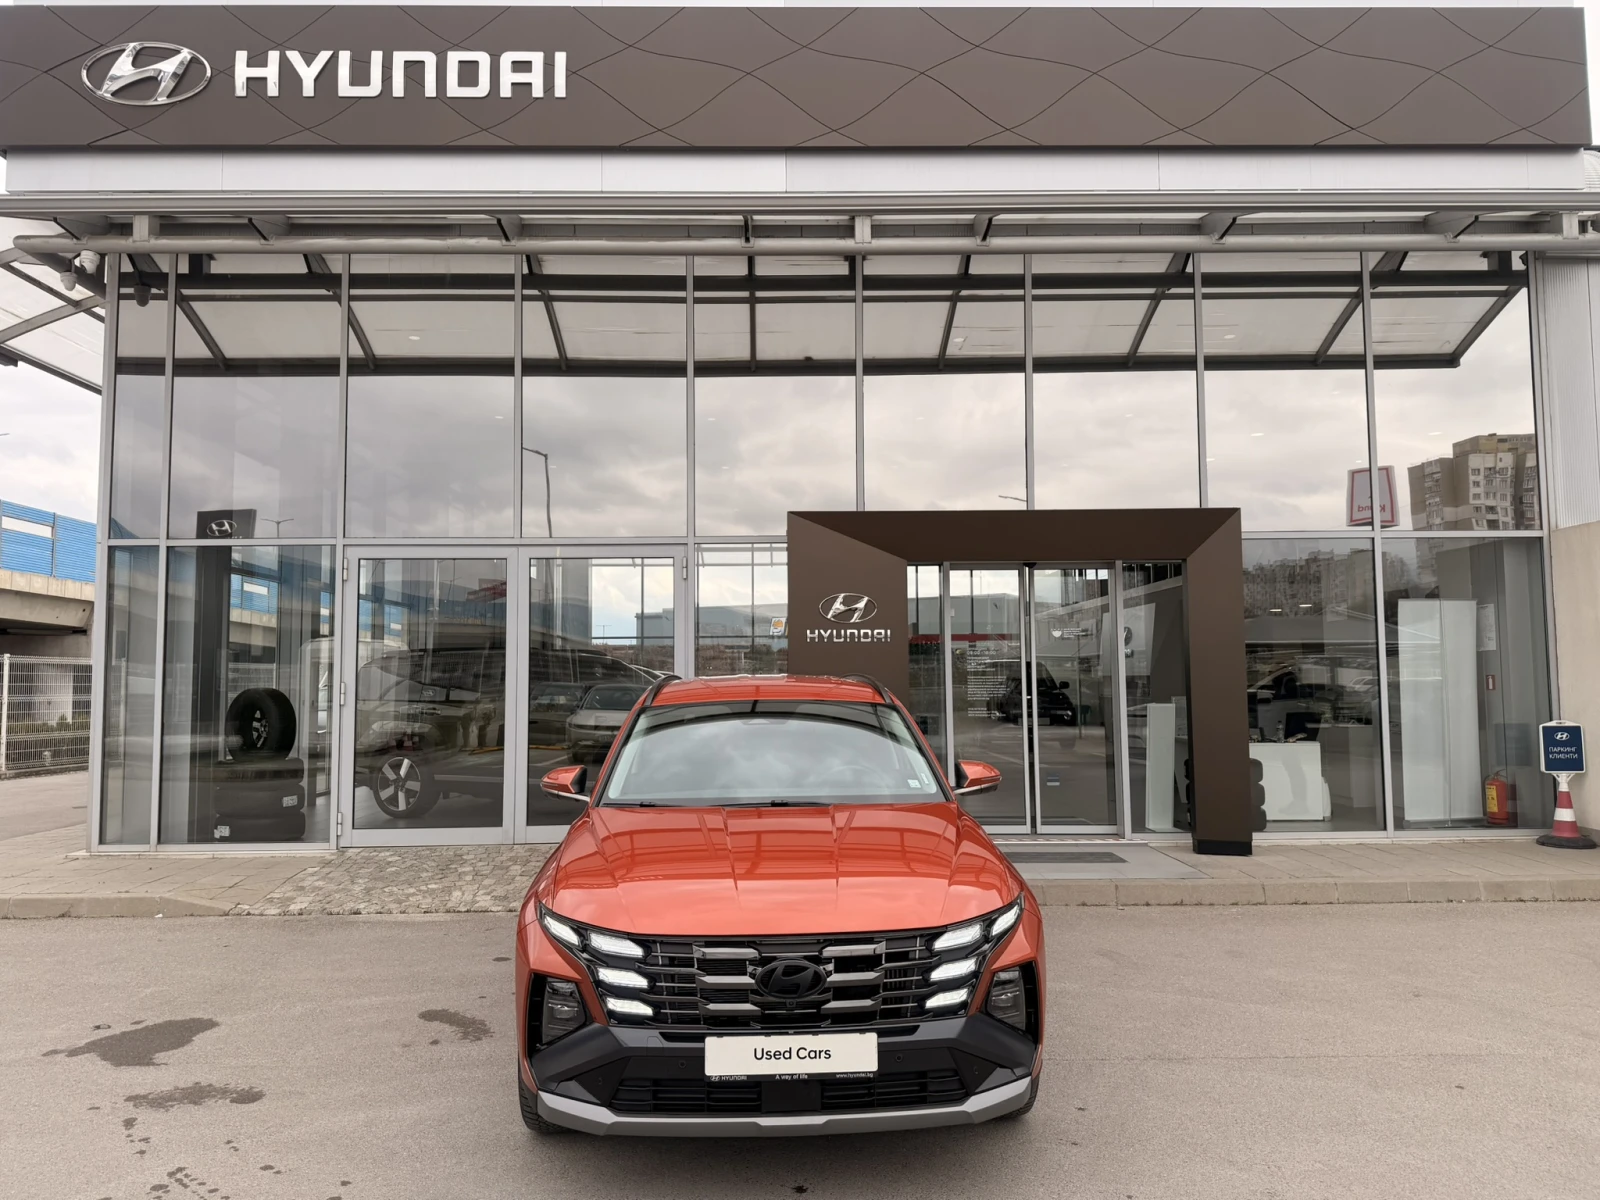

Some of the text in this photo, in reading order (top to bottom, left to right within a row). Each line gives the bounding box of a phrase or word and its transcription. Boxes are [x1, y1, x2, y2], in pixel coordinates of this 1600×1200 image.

[234, 50, 567, 97] HYUNDAI
[806, 629, 891, 642] HYUNDAI
[754, 1046, 832, 1060] Used Cars
